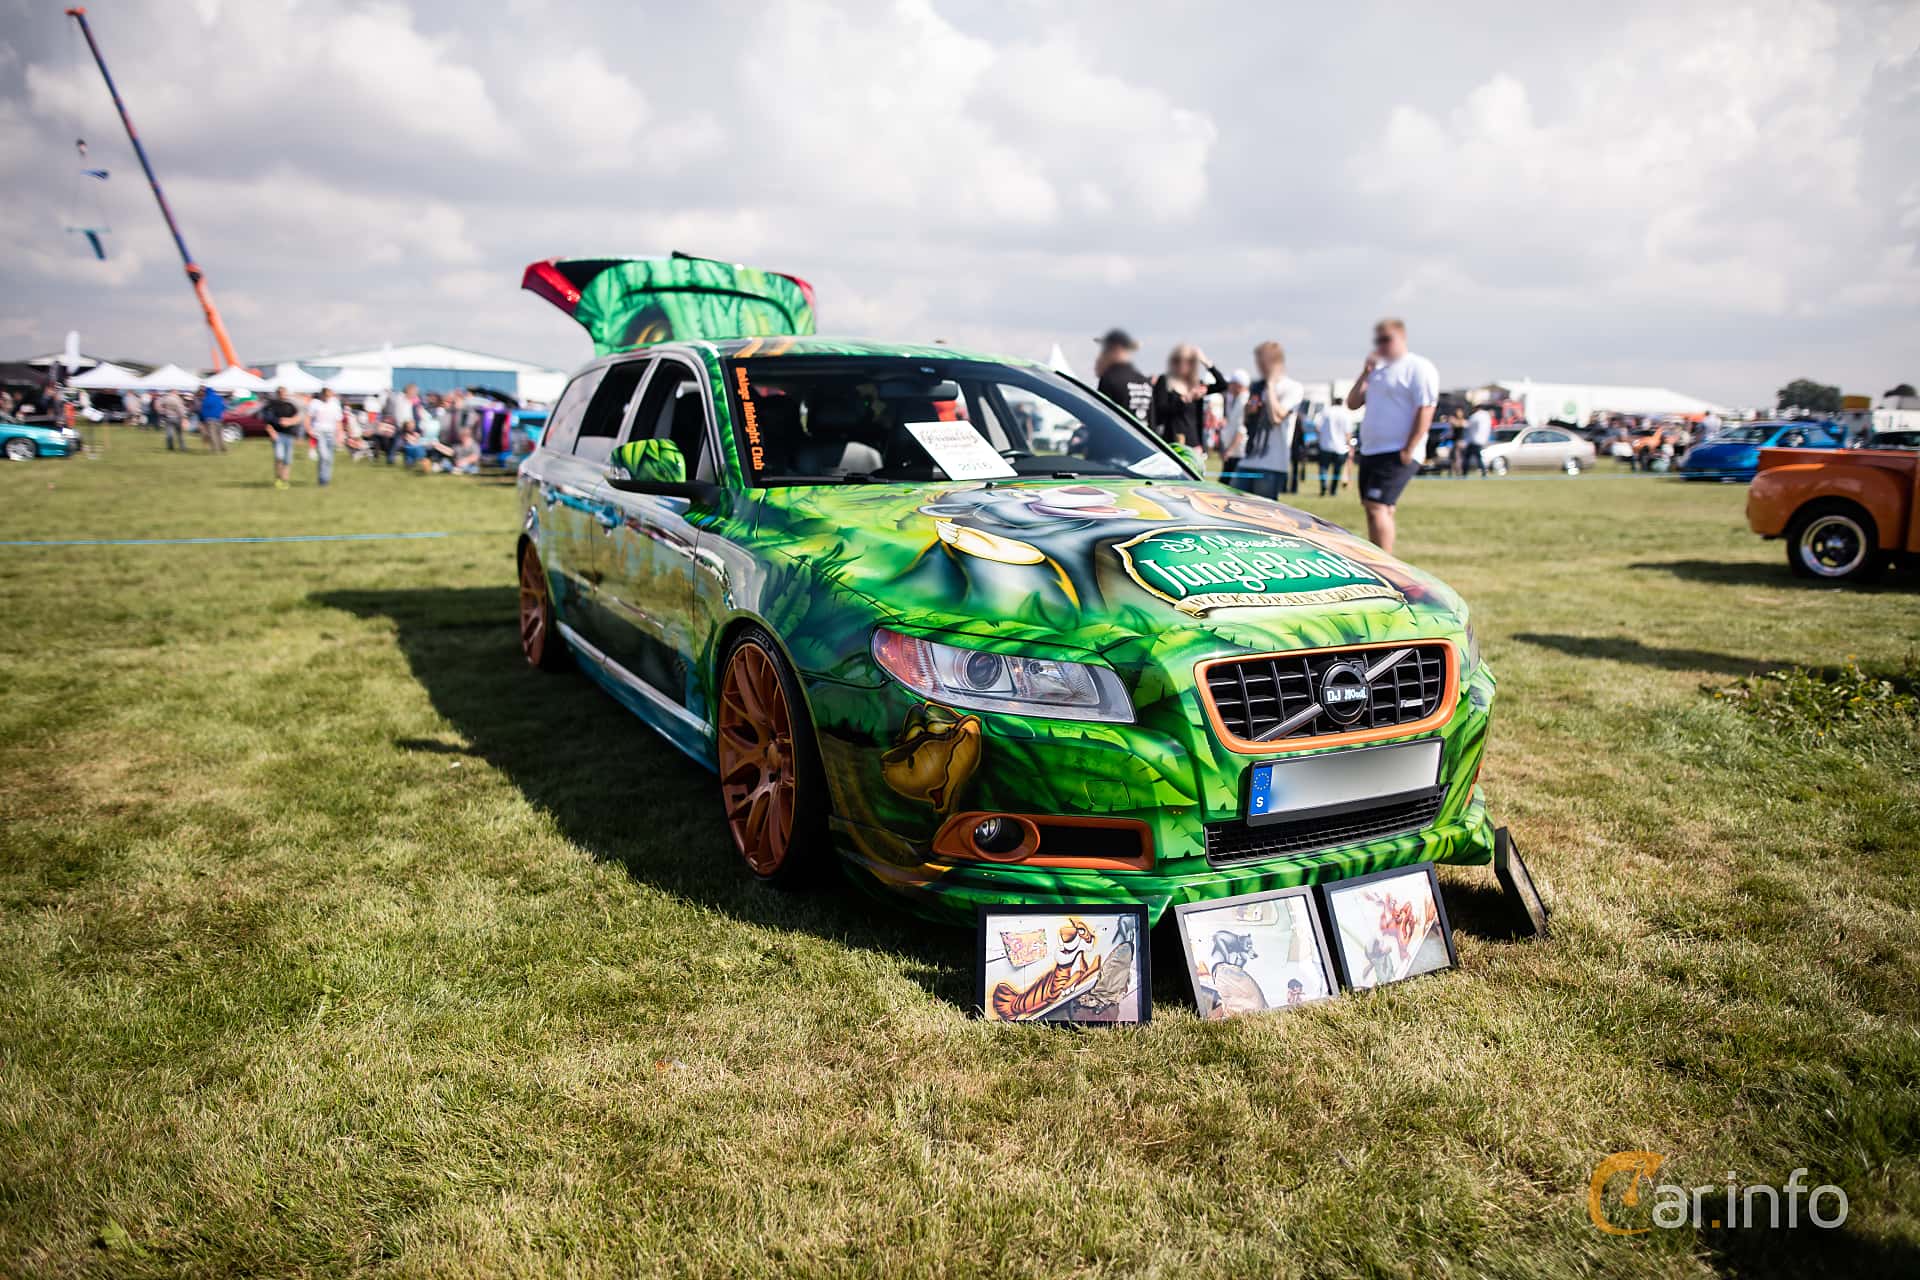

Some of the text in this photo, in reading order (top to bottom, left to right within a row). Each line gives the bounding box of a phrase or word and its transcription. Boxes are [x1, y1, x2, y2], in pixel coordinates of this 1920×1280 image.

[743, 402, 760, 445] Midnight
[751, 447, 765, 470] Club
[1327, 689, 1341, 702] DJ
[1256, 796, 1264, 808] S
